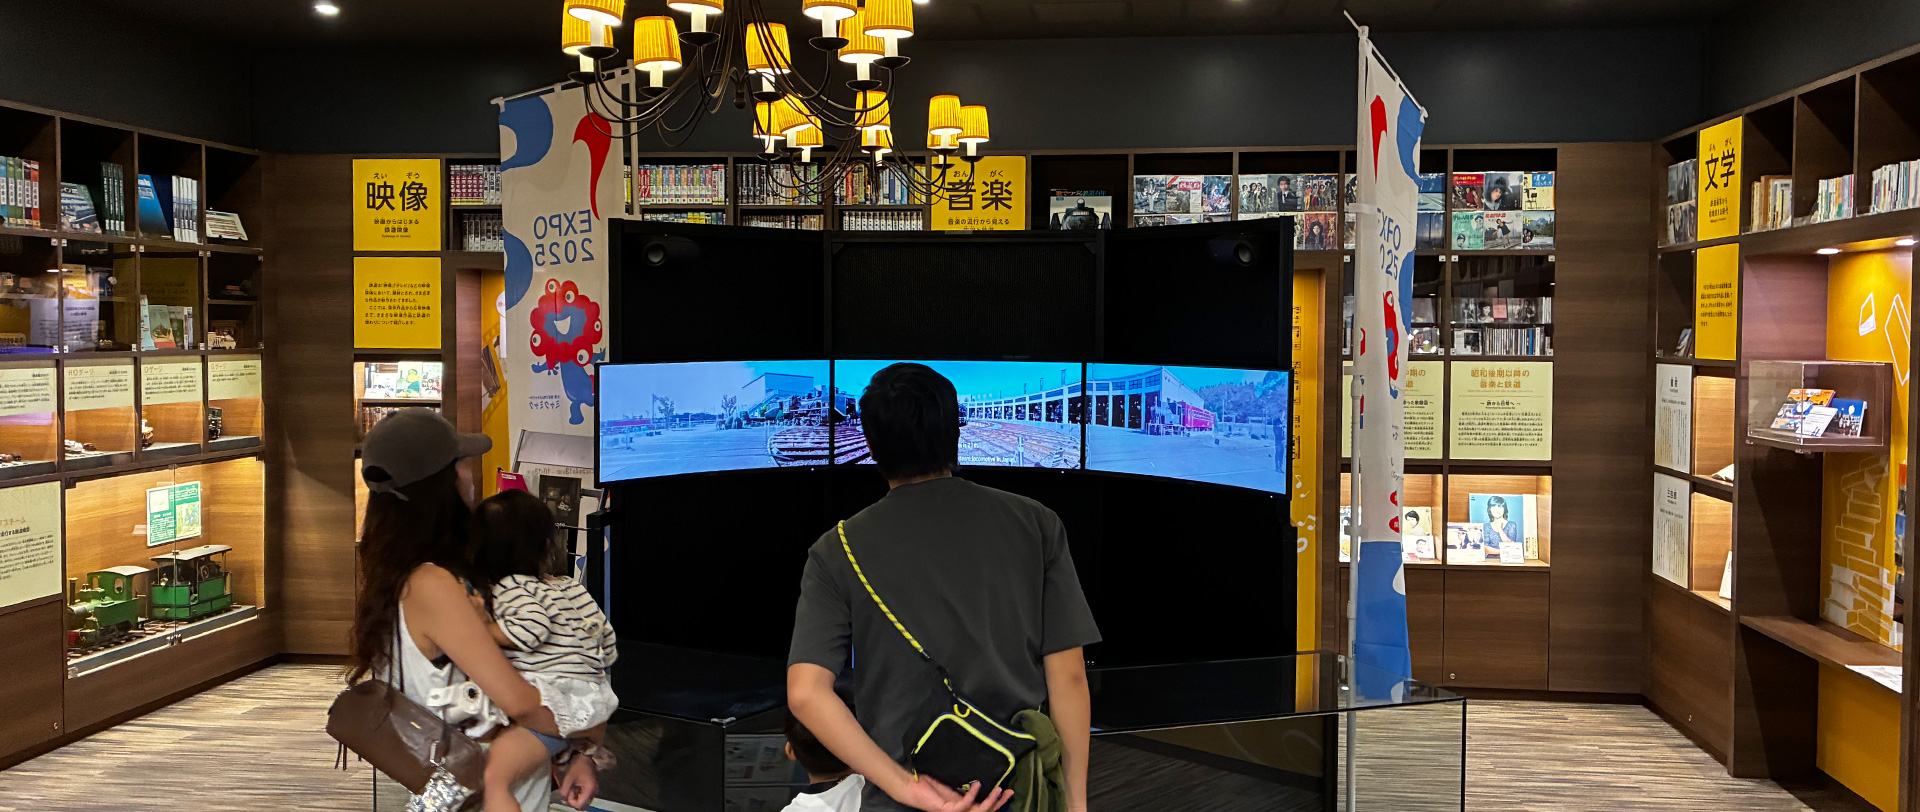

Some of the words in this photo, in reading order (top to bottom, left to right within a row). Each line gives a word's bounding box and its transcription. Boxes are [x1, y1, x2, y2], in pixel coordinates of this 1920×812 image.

[373, 172, 388, 180] えい
[406, 171, 420, 180] ぞう
[953, 170, 969, 178] おん
[989, 169, 1004, 178] がく
[1704, 147, 1736, 193] 文学
[366, 180, 429, 212] 映像
[945, 179, 1013, 211] 音楽
[1376, 207, 1402, 251] XPO
[1470, 369, 1530, 378] 昭和後期以降の
[1479, 380, 1522, 389] 音楽と鉄道
